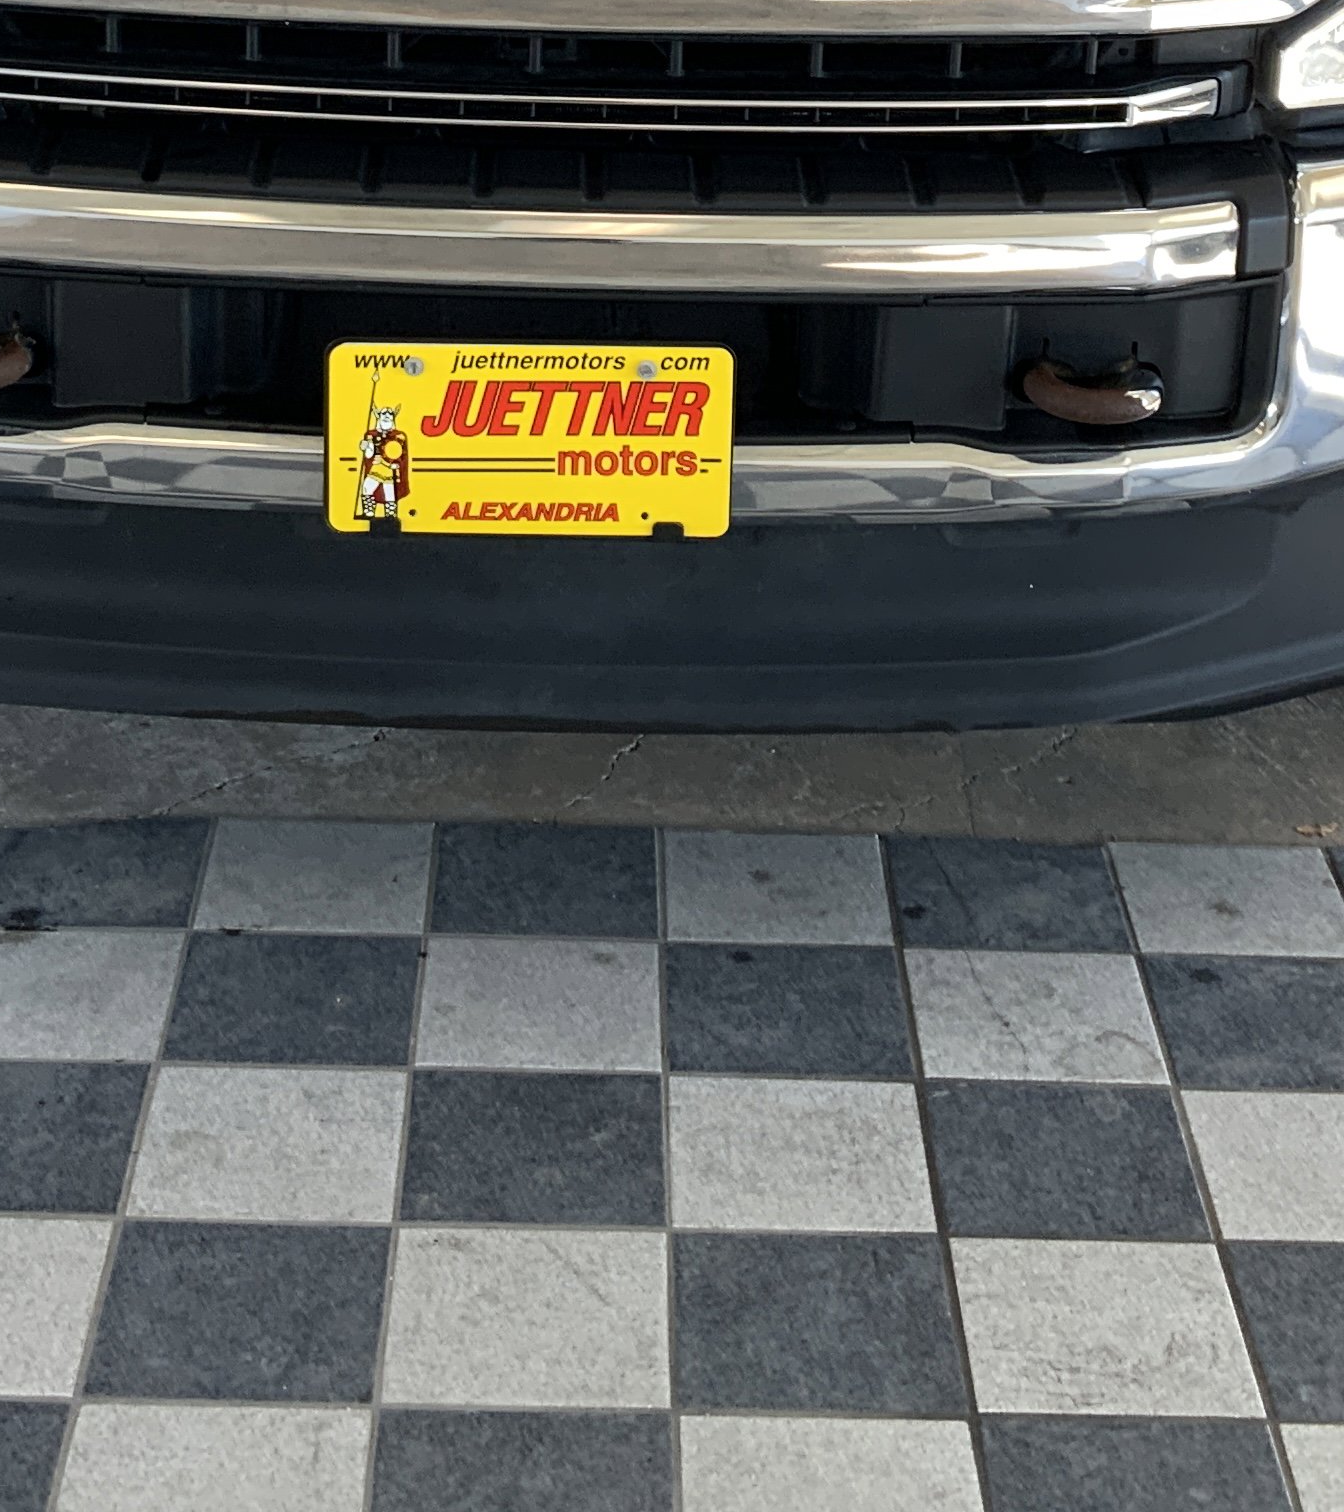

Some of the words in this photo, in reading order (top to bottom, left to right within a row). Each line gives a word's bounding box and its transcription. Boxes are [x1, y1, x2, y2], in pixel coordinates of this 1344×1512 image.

[451, 350, 626, 375] juettnermotors
[420, 379, 711, 438] JUETTNER
[557, 445, 699, 477] motors
[441, 501, 620, 523] ALEXANDRIA
